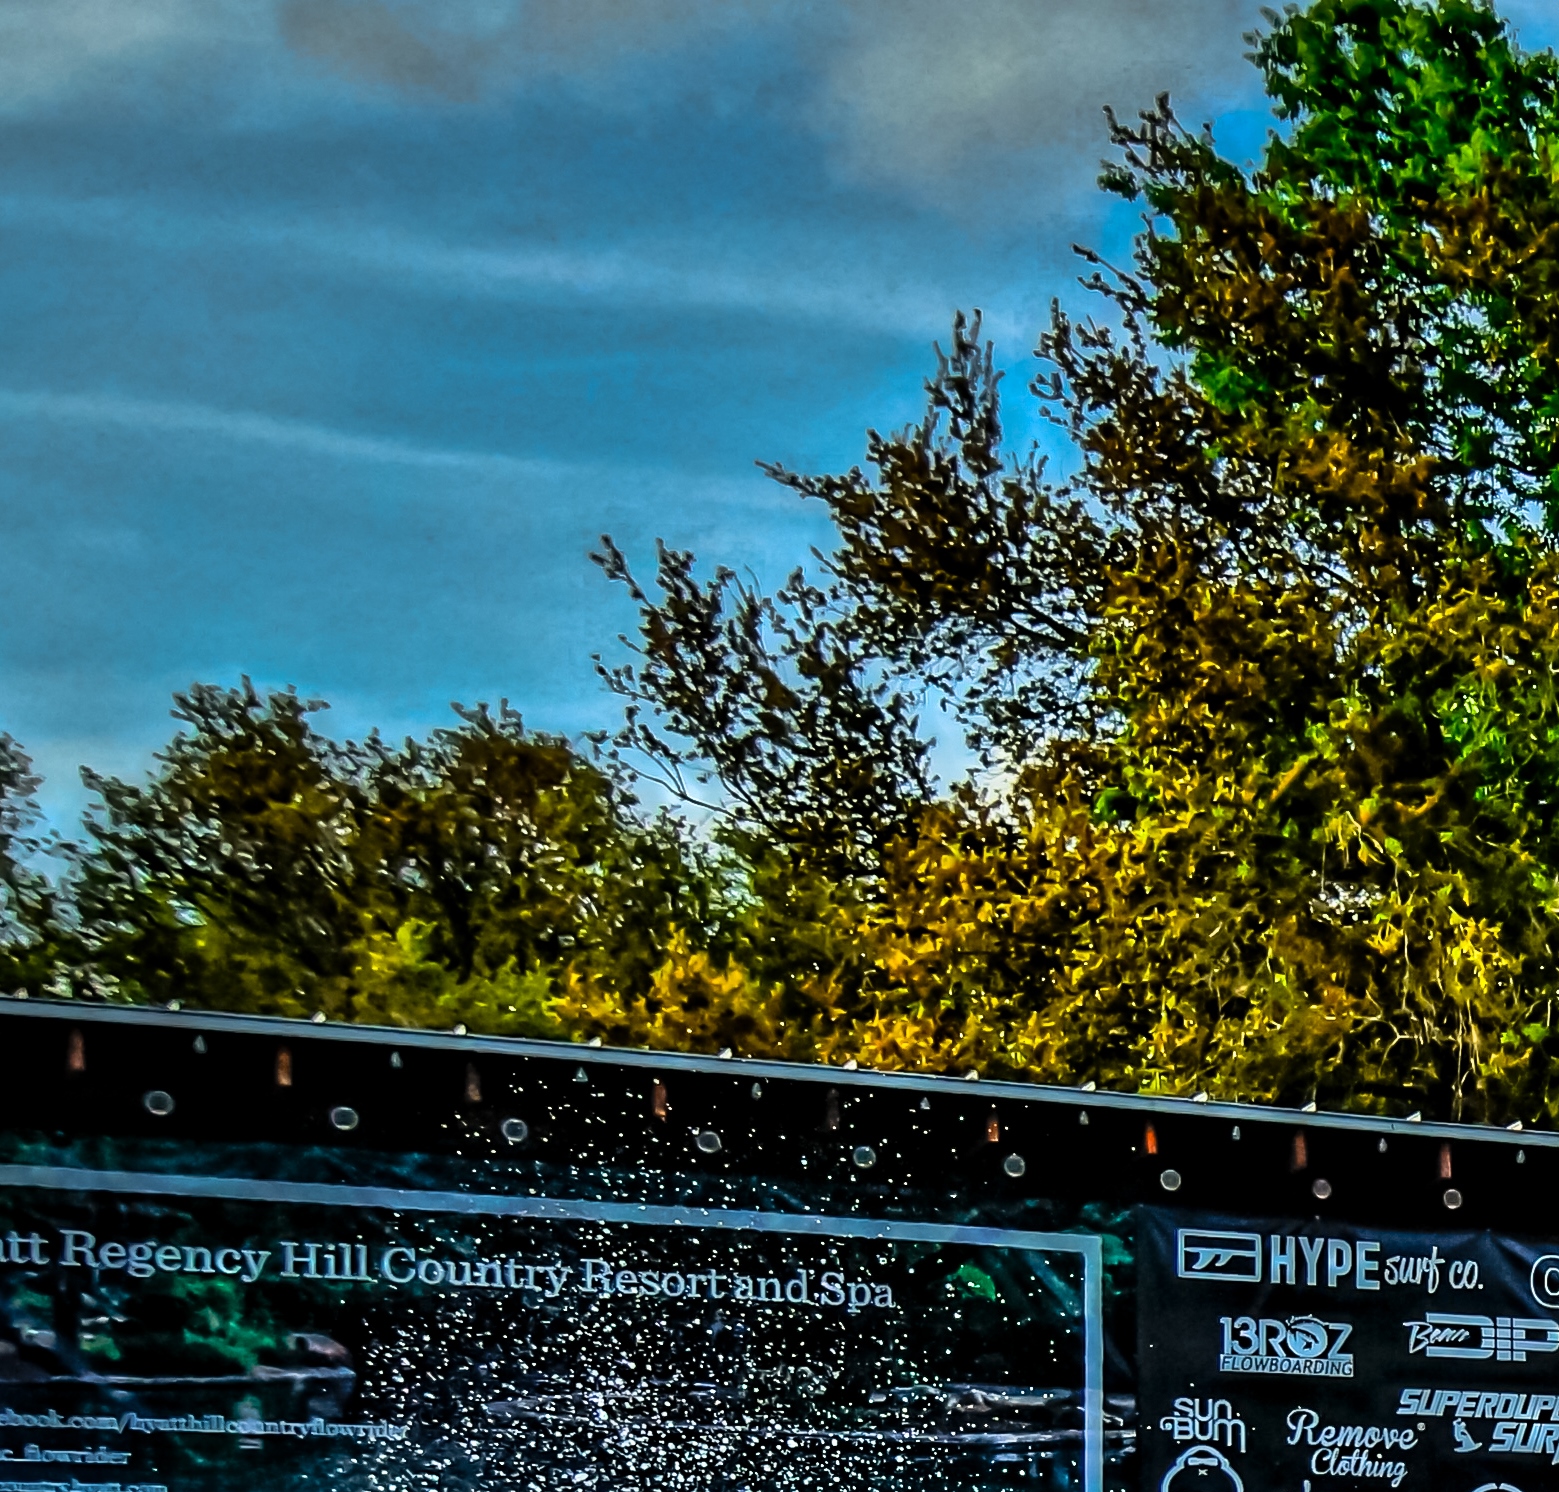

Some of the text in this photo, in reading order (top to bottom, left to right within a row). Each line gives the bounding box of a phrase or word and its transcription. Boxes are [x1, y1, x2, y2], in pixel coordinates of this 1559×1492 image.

[59, 1229, 271, 1282] Regency
[281, 1241, 371, 1281] Hill
[382, 1247, 572, 1298] Country
[580, 1258, 727, 1299] Resort
[731, 1269, 813, 1303] and
[820, 1271, 896, 1313] Spa
[1270, 1234, 1380, 1290] HYPE
[1220, 1355, 1354, 1377] FLOWBOARDING
[1286, 1407, 1418, 1450] Remove
[1311, 1448, 1408, 1487] Clothing
